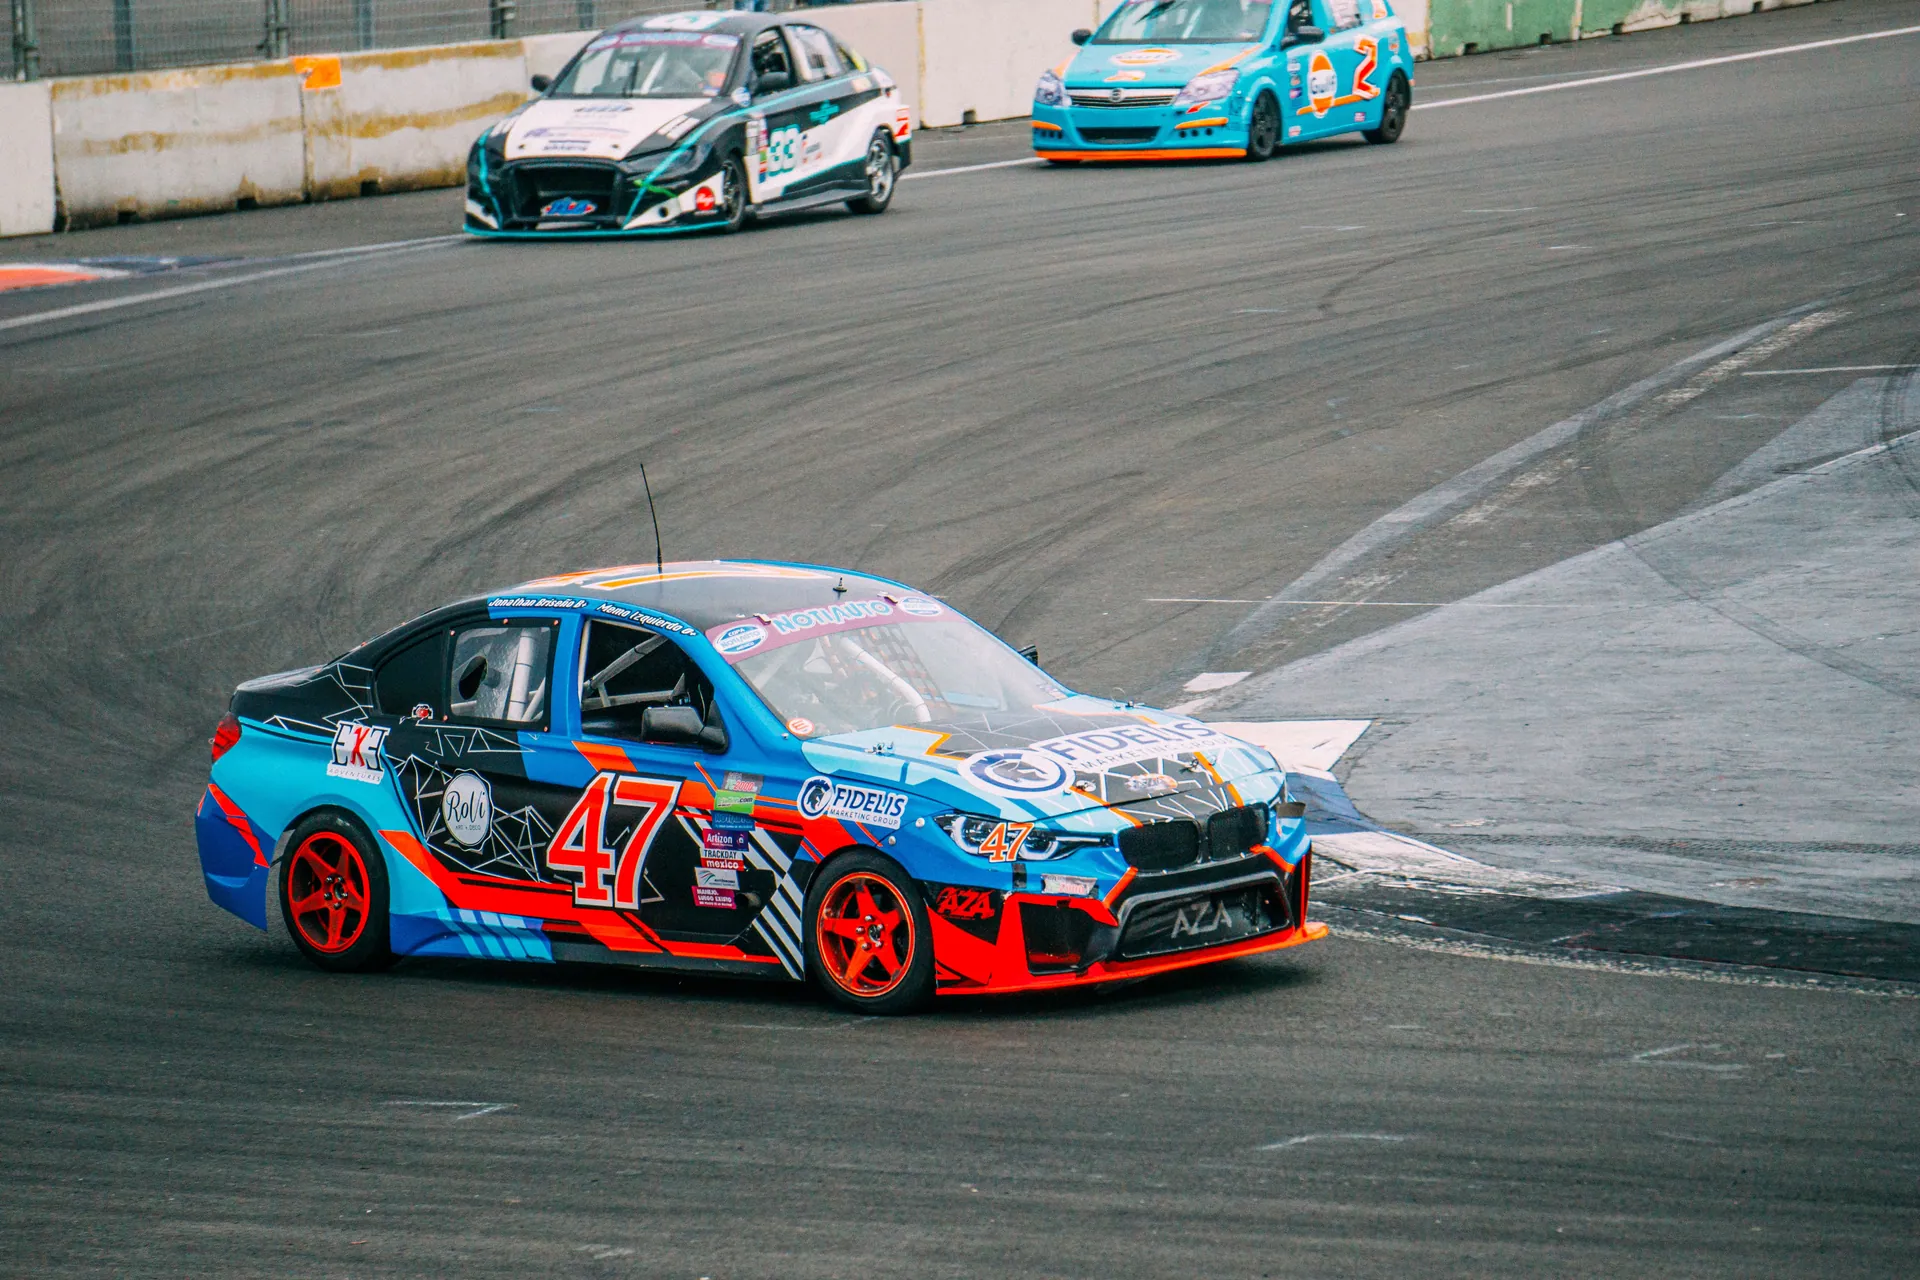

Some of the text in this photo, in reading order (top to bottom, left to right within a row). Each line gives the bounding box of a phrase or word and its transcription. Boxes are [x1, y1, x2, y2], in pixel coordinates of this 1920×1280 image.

[1353, 35, 1381, 99] 2
[768, 124, 801, 177] 33
[488, 598, 534, 607] Jonathan
[534, 599, 574, 608] Briseño
[596, 603, 631, 618] Memo
[629, 612, 682, 632] Izquierdo
[773, 600, 892, 633] NOTIAUTO
[1041, 722, 1217, 761] FIDELIS
[1079, 742, 1177, 769] MARKETING
[328, 767, 382, 782] ADVENTURES
[829, 808, 899, 826] MARKETING GROUP
[832, 787, 906, 817] FIDELIS
[546, 771, 683, 910] 47
[706, 832, 733, 844] Artizon
[979, 821, 1035, 863] 47
[704, 849, 738, 859] TRACKDAY
[706, 859, 739, 869] mexico
[935, 886, 996, 920] AZA
[1170, 899, 1233, 939] AZA
